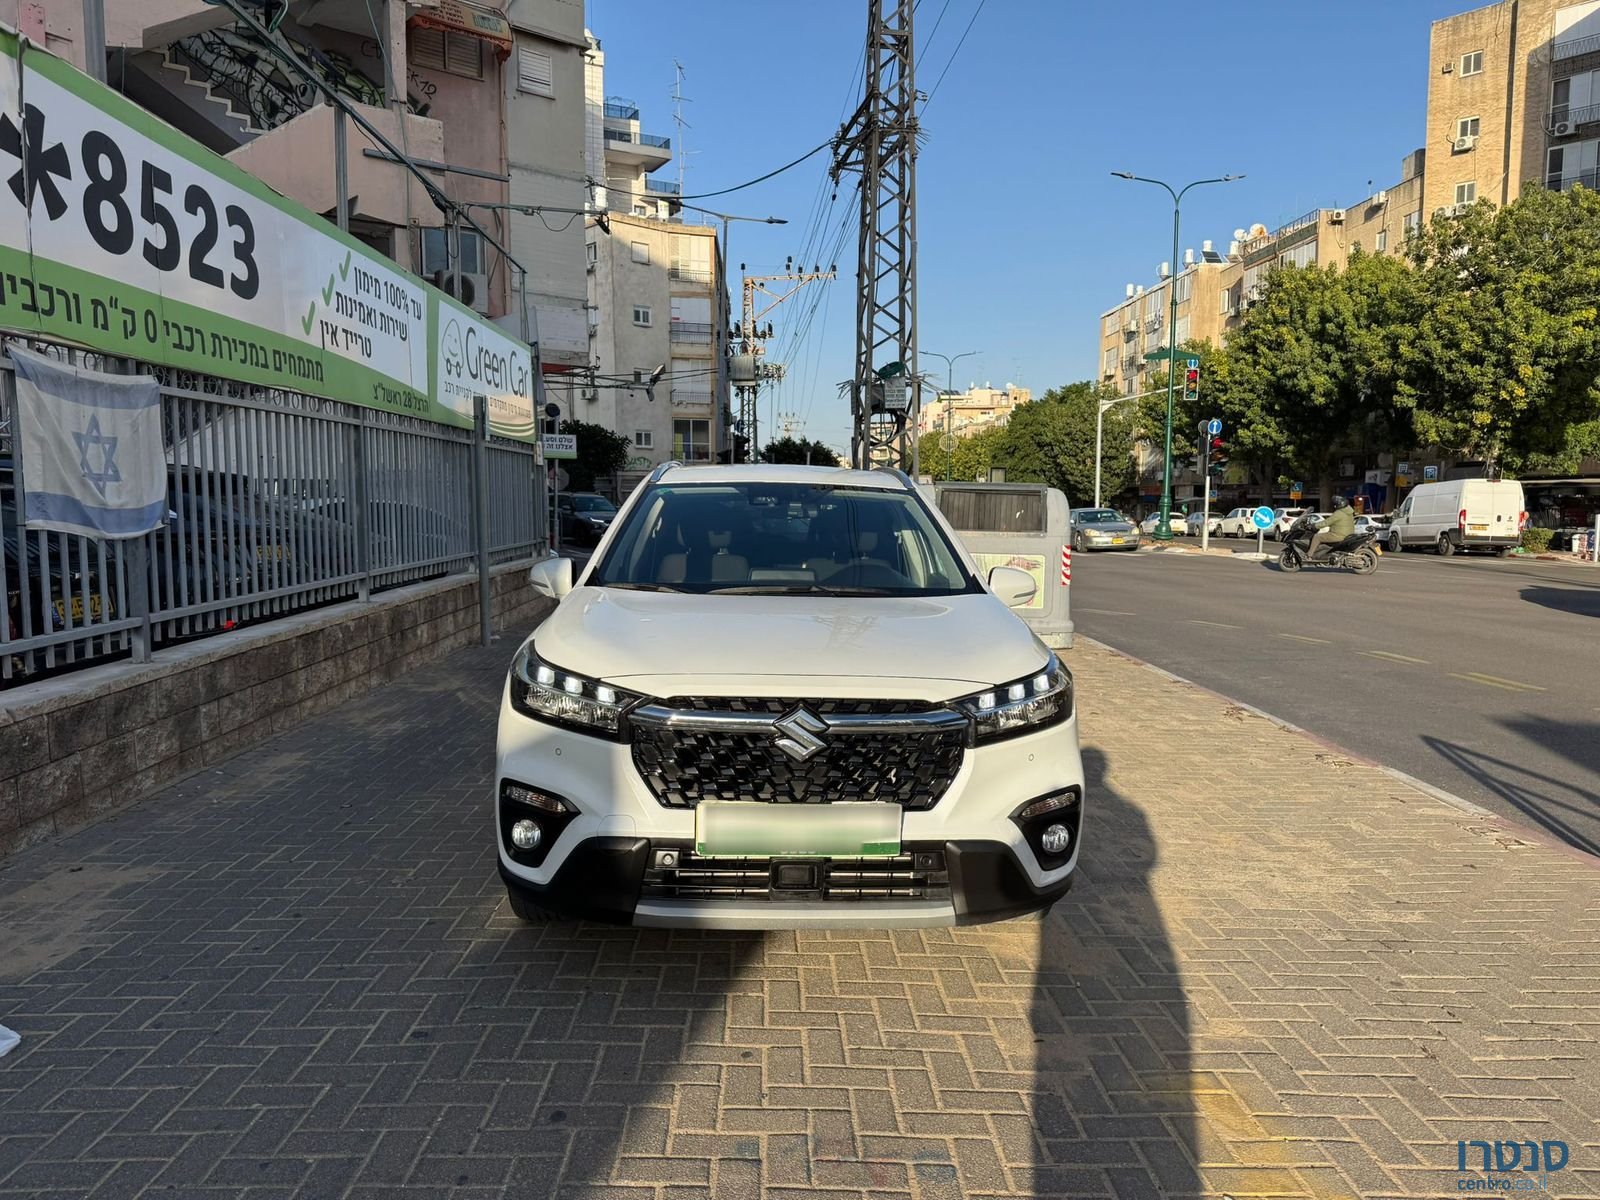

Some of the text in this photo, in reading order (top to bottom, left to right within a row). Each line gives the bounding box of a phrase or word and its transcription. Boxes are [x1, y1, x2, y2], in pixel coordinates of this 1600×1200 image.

[0, 272, 82, 325] ורכבי
[354, 266, 422, 320] עד 100% מימון
[144, 308, 157, 343] 0
[335, 291, 407, 341] שירות ואמינות
[163, 320, 206, 355] רכבי
[211, 332, 269, 370] במכירת
[320, 319, 372, 358] טרייד אין
[273, 349, 324, 382] מתמחים
[466, 326, 528, 399] Green Car
[403, 390, 412, 409] 28
[413, 392, 429, 413] הרצל
